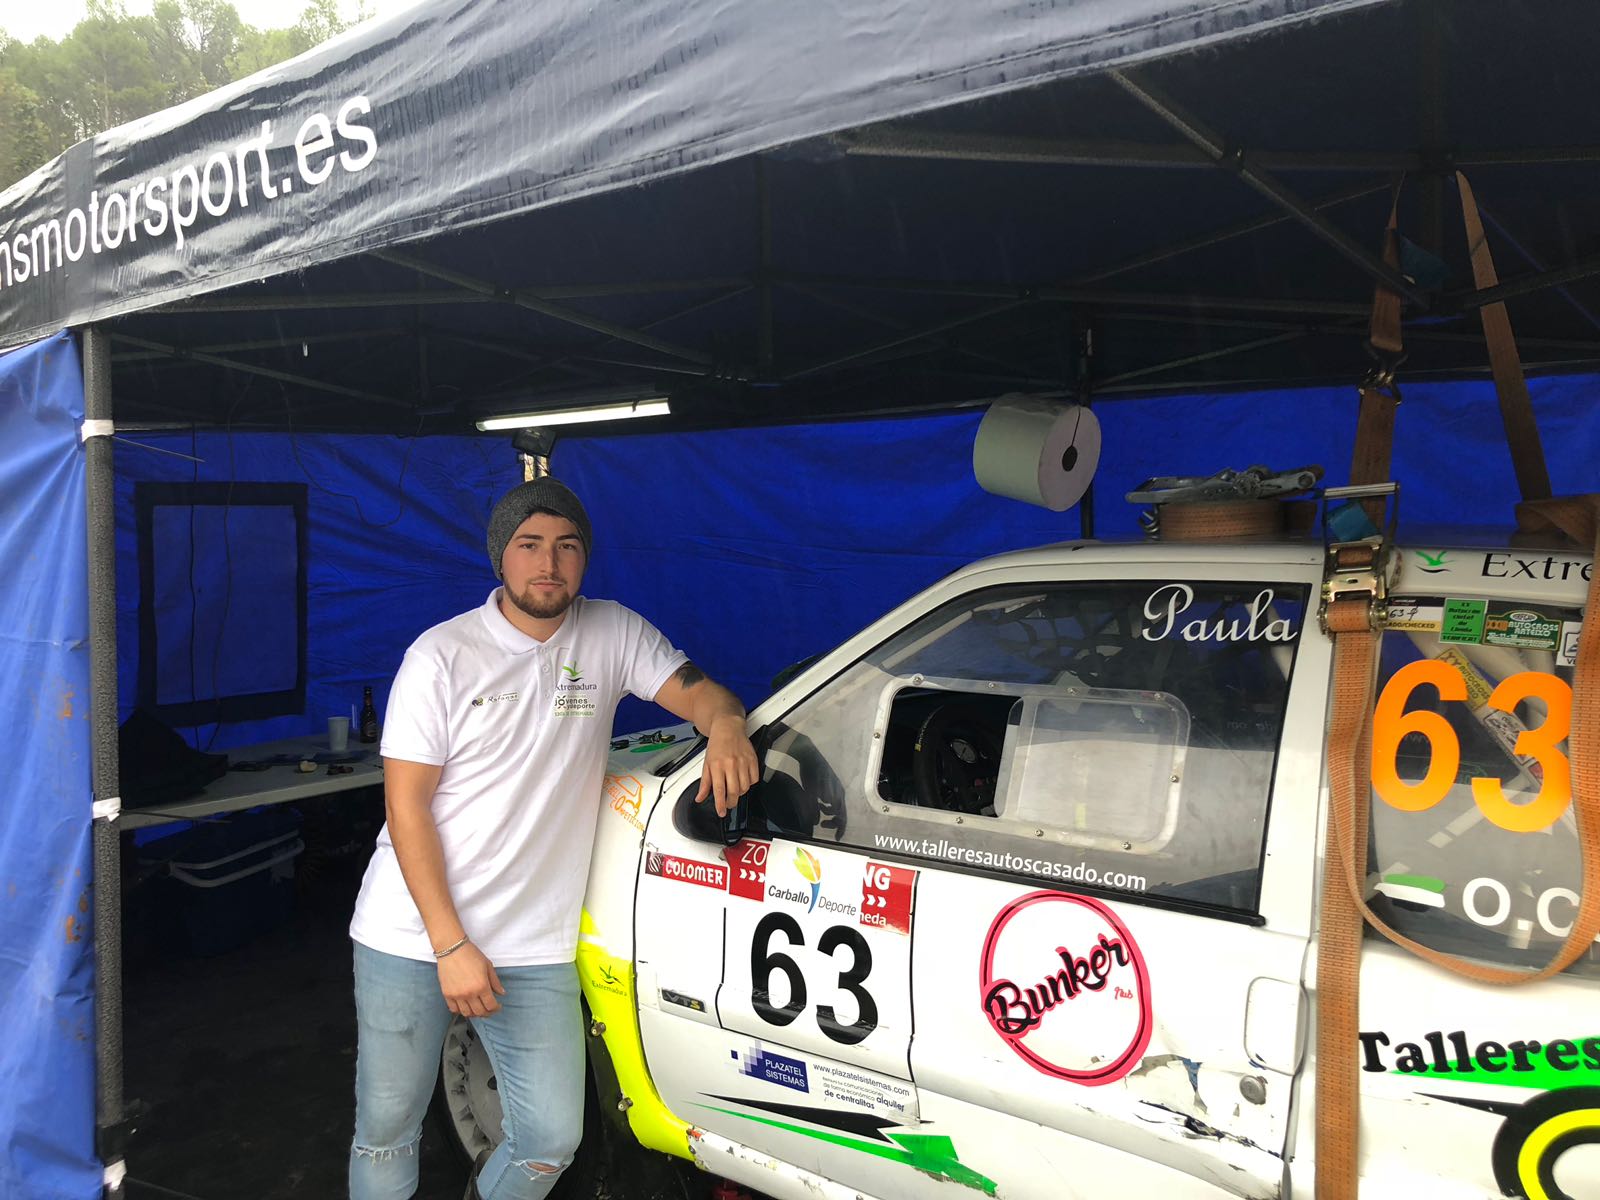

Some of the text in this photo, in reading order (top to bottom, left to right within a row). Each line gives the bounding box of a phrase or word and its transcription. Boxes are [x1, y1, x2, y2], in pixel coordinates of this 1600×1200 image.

[1142, 583, 1298, 641] Paula
[1371, 658, 1573, 833] 63
[664, 858, 724, 886] COLOMER
[874, 834, 1147, 891] www.talleresautoscasado.com
[768, 885, 857, 917] Carballo Deporte
[750, 911, 879, 1046] 63
[981, 933, 1130, 1038] Bunker
[765, 1058, 805, 1078] PLAZATEL
[1358, 1030, 1600, 1073] Talleres
[765, 1069, 806, 1088] SISTEMAS
[812, 1063, 910, 1097] www.plazatelsistemas.com
[824, 1089, 875, 1110] de centralitas
[876, 1095, 905, 1112] alquiler
